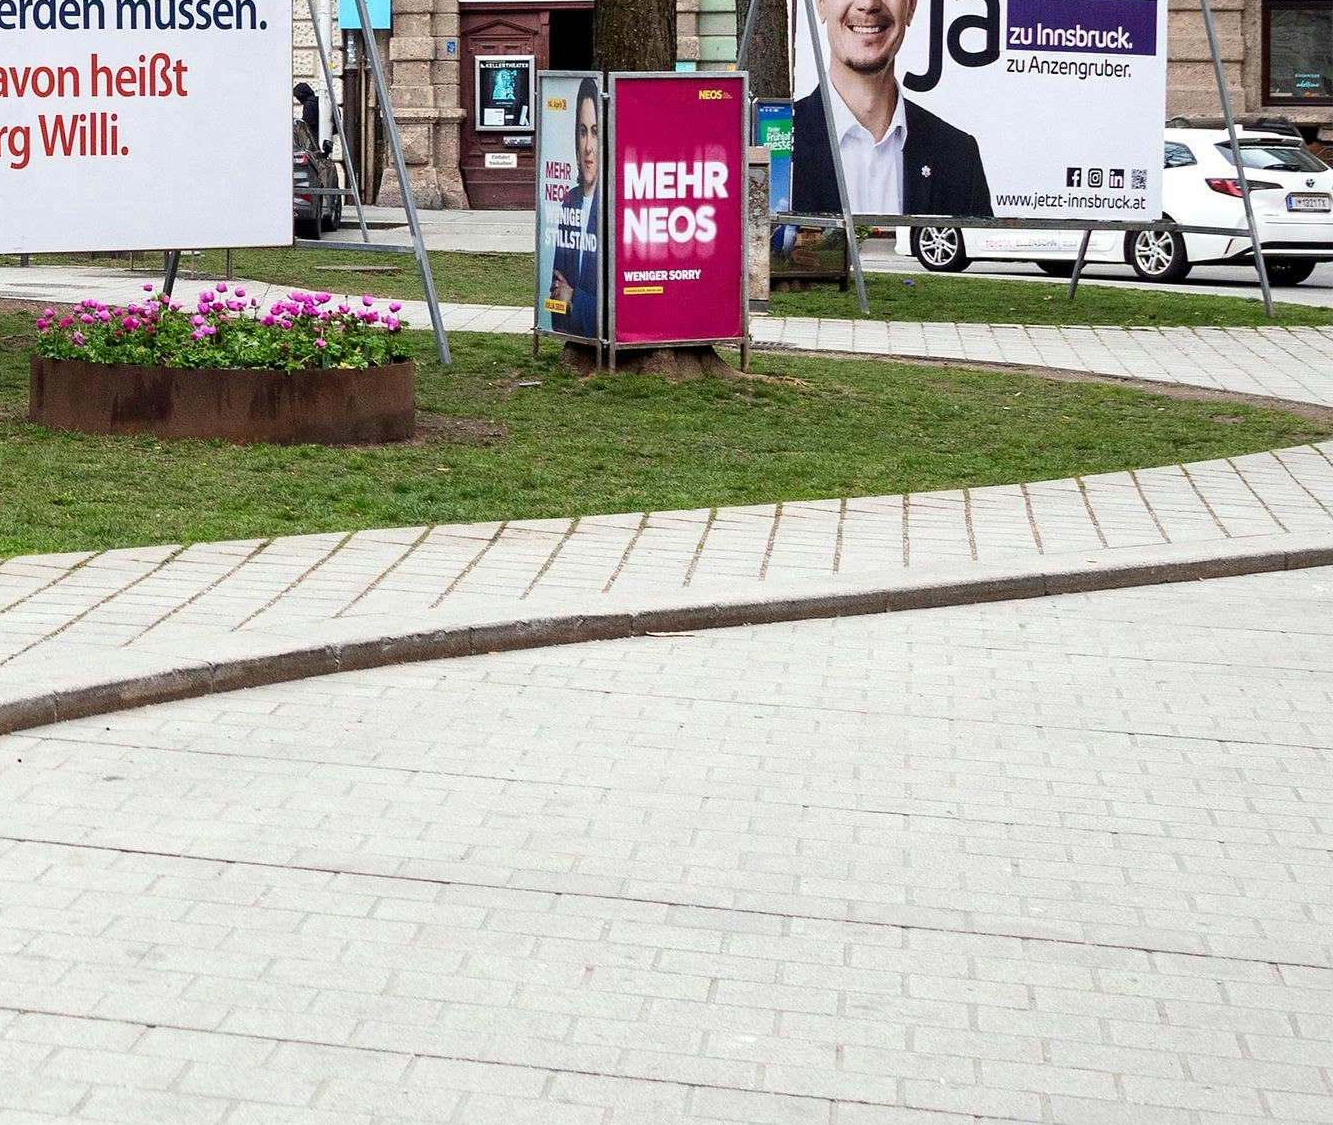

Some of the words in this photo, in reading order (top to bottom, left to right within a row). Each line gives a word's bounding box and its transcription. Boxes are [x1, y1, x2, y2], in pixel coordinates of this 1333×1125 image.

[1009, 26, 1032, 46] zu
[1037, 23, 1133, 50] Innsbruck.
[90, 52, 188, 98] heißt
[1006, 58, 1025, 73] zu
[1028, 55, 1131, 80] Anzengruber.
[699, 89, 723, 100] NEOS
[38, 113, 129, 158] Willi.
[545, 160, 572, 181] MEHR
[623, 161, 729, 201] MEHR
[545, 183, 570, 205] NEOS
[996, 192, 1146, 210] www.jetzt-innsbruck.at
[545, 204, 588, 227] WENIGER
[623, 205, 718, 246] NEOS
[544, 229, 597, 252] STILLSTAND
[624, 270, 668, 282] WENIGER
[669, 269, 701, 280] SORRY
